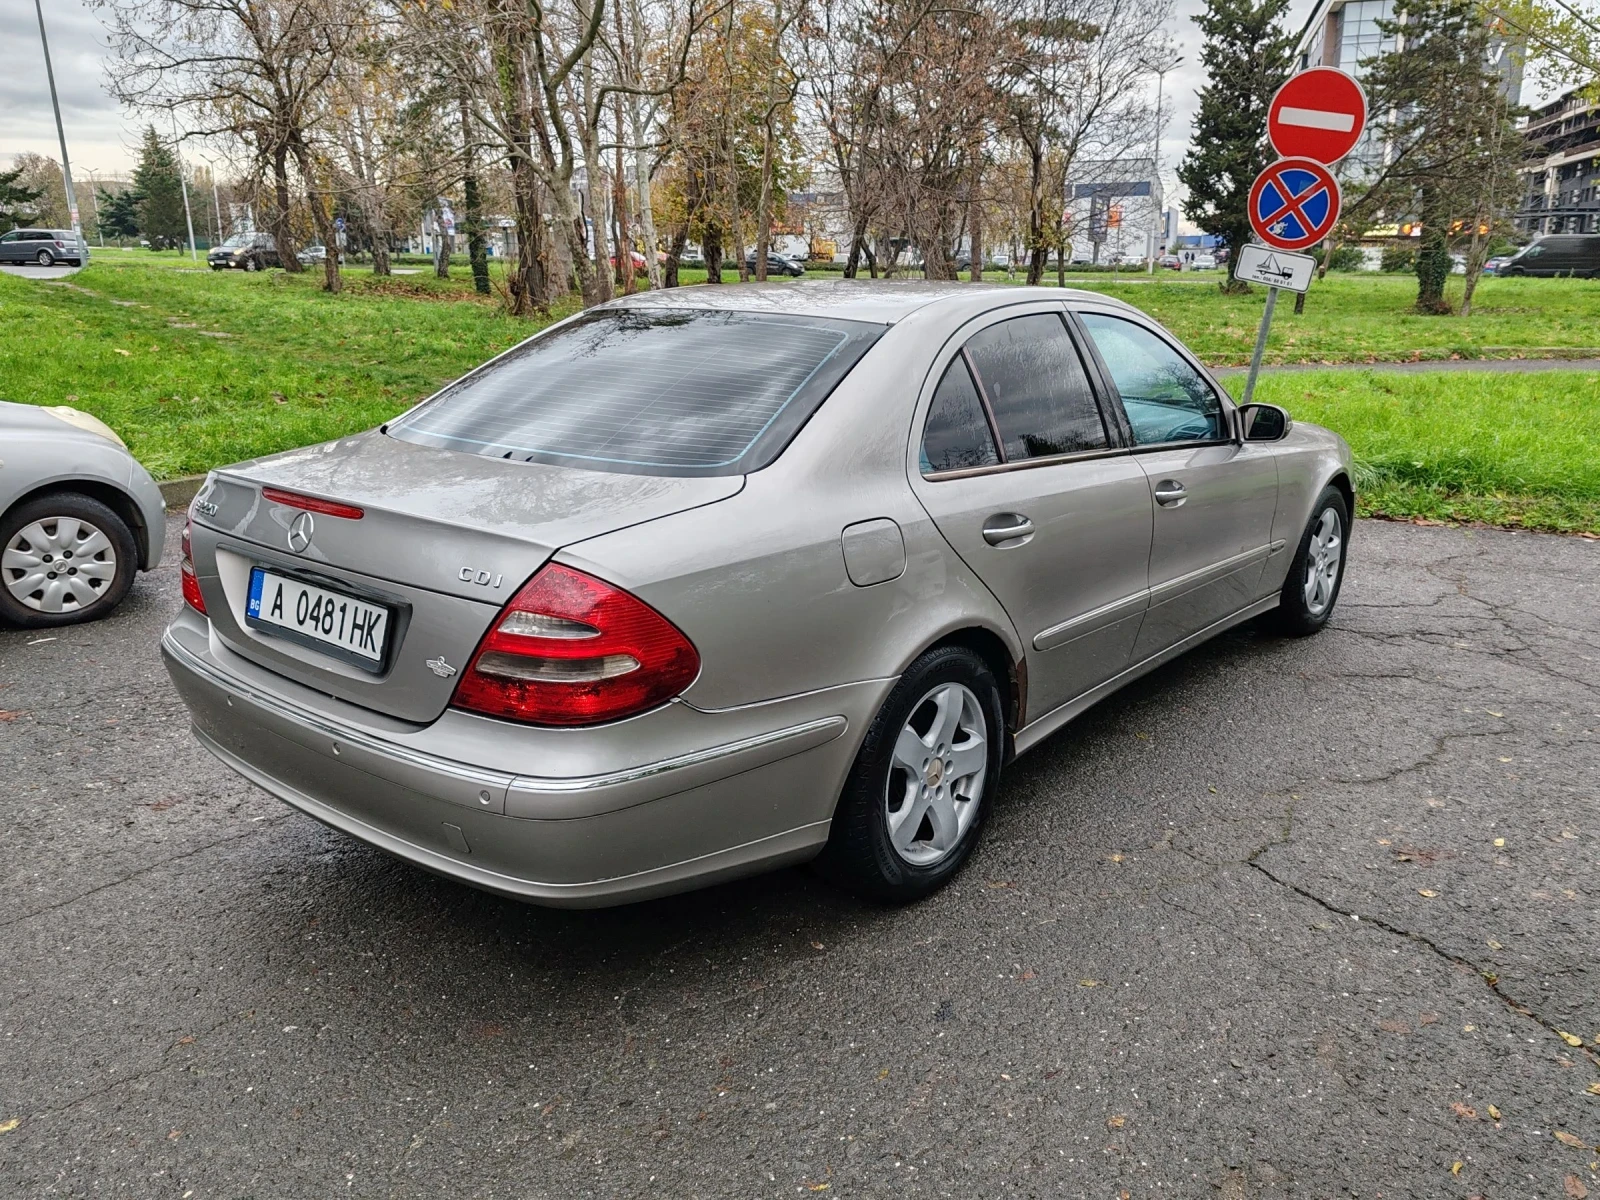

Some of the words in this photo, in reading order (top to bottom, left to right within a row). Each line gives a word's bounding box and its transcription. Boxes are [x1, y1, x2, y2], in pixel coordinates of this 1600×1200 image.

[458, 566, 503, 588] CDI
[250, 598, 260, 611] BG
[270, 582, 283, 620] A
[296, 589, 347, 640] 0481
[350, 605, 382, 653] HK
